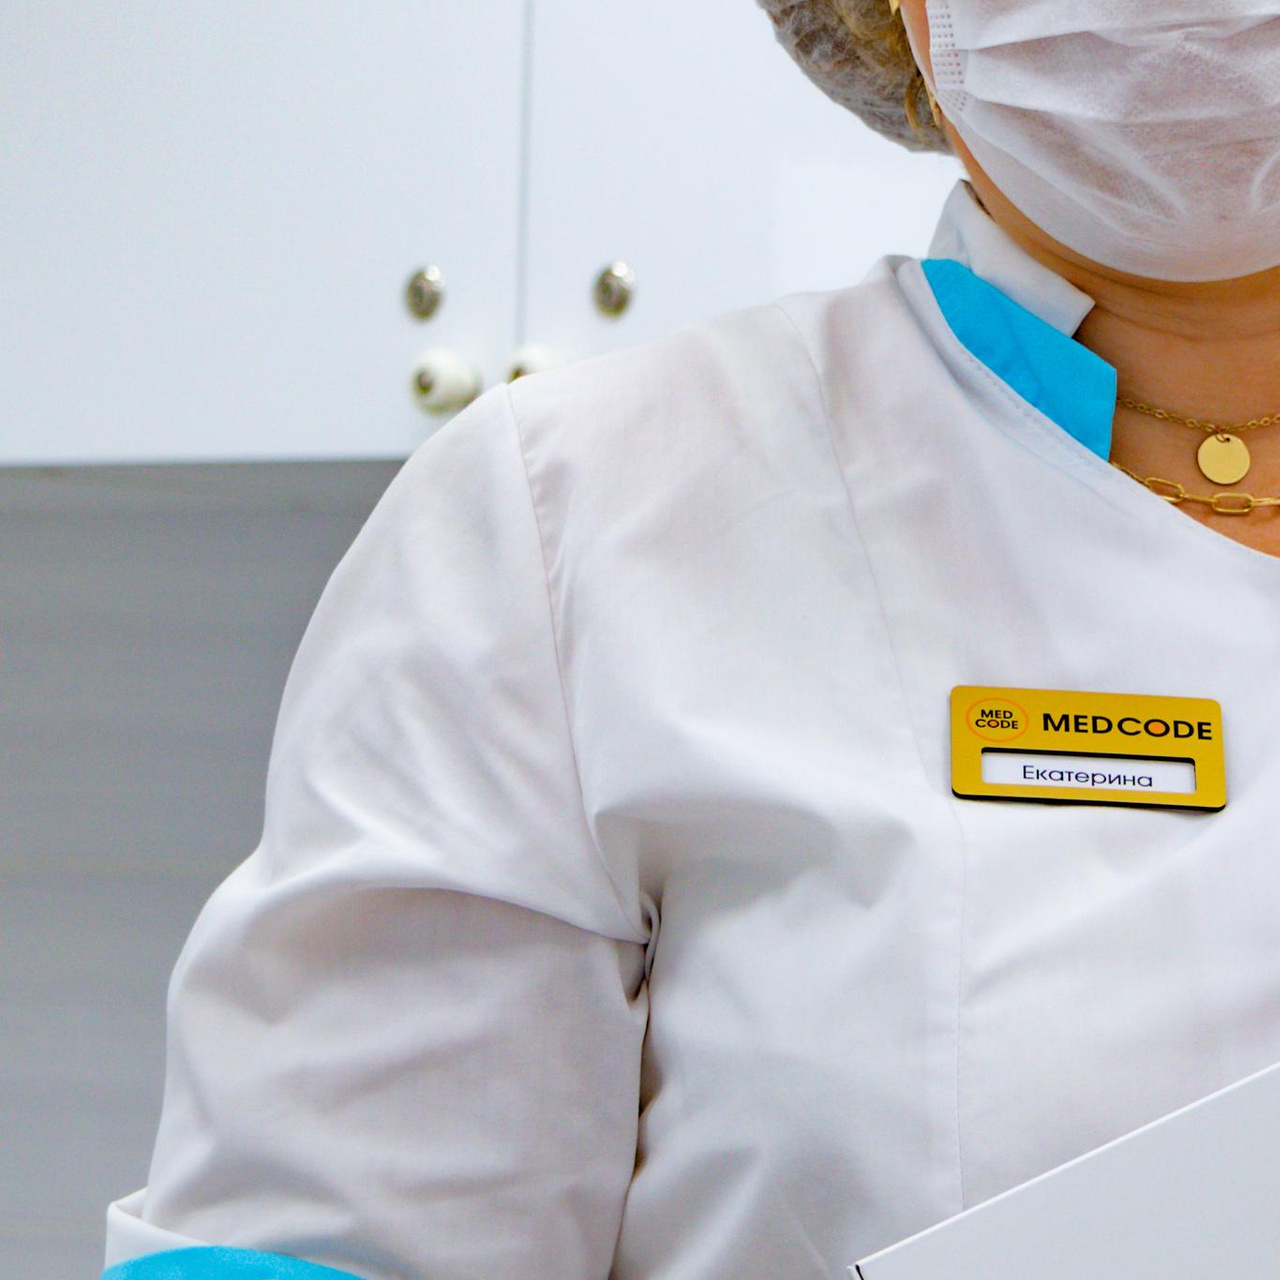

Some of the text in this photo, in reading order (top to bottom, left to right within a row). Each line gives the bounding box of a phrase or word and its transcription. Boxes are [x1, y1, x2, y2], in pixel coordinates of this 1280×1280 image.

[980, 709, 1013, 719] MED
[975, 719, 1019, 730] CODE
[1042, 713, 1213, 741] MEDCODE
[1022, 765, 1153, 787] Екатерина
